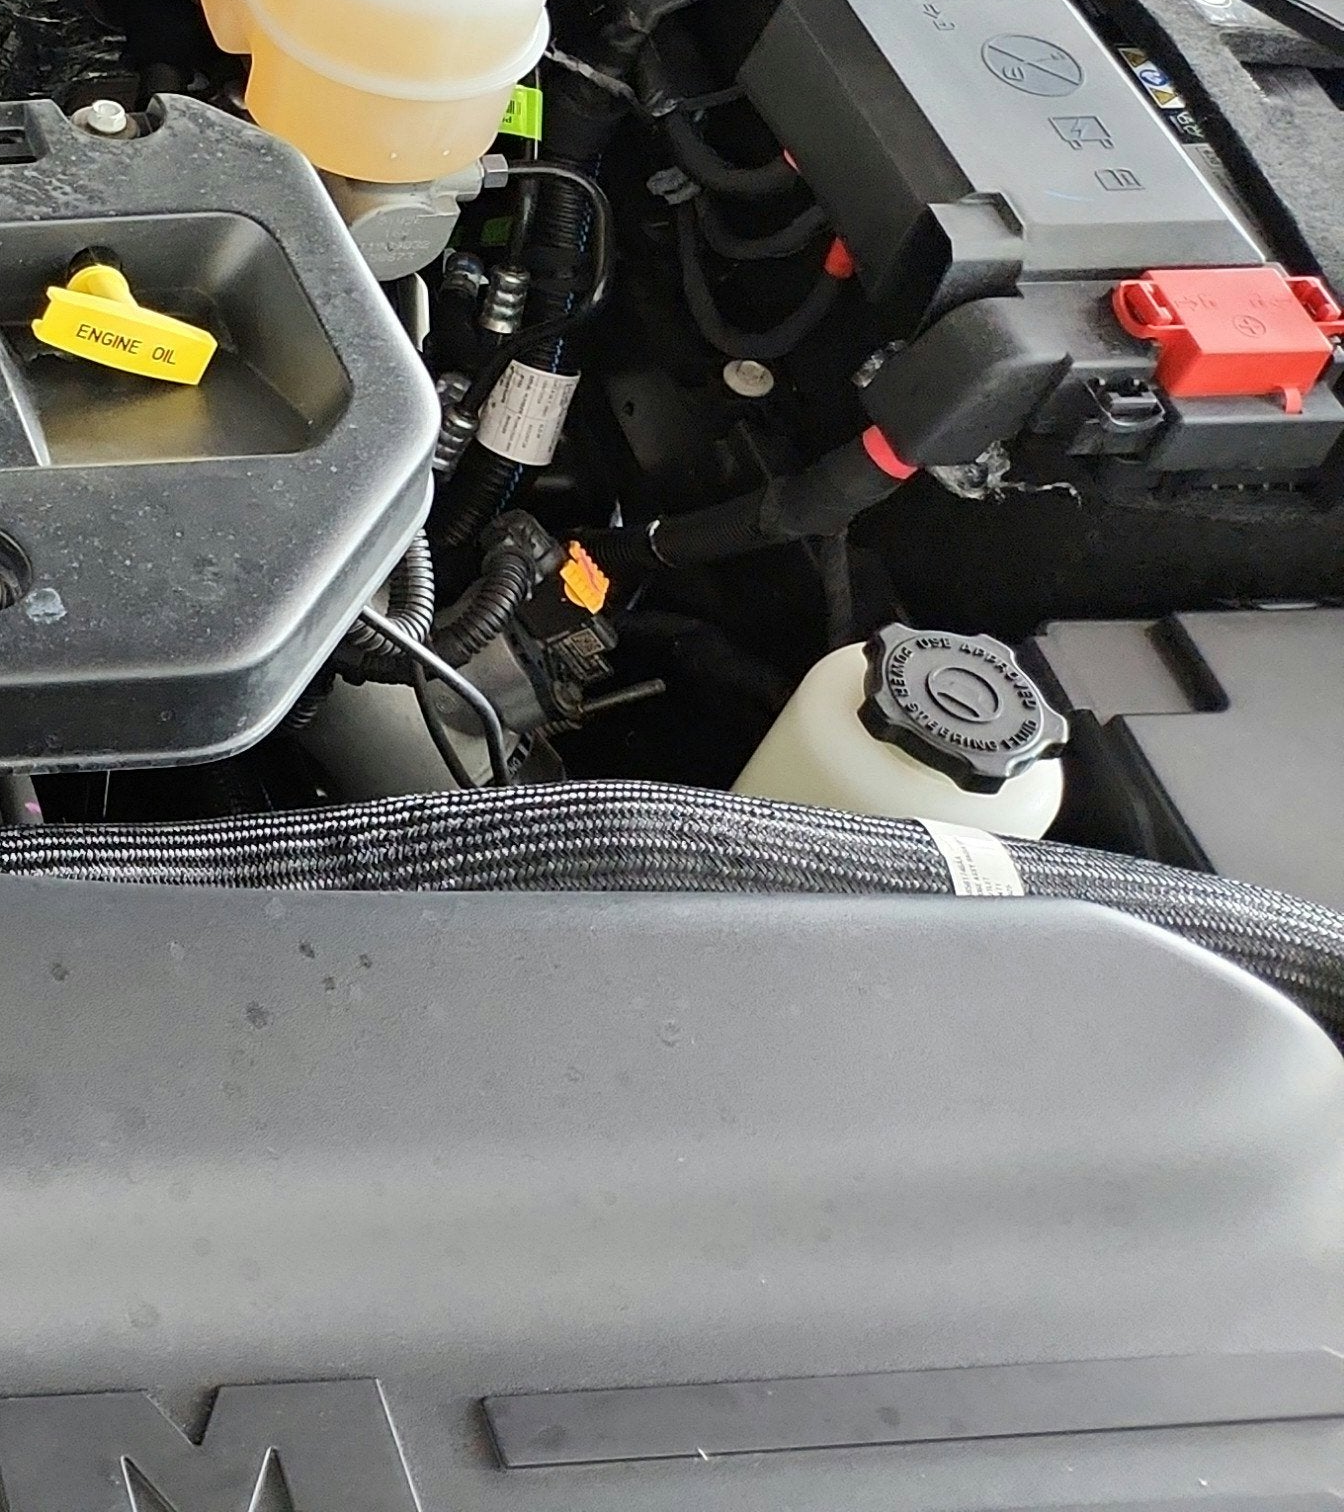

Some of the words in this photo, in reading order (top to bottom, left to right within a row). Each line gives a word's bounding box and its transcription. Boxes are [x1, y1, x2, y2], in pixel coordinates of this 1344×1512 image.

[75, 323, 143, 356] ENGINE
[151, 346, 177, 366] OIL
[915, 637, 952, 651] USE
[960, 642, 1037, 710] APPROVED
[905, 702, 1000, 752] STEERING
